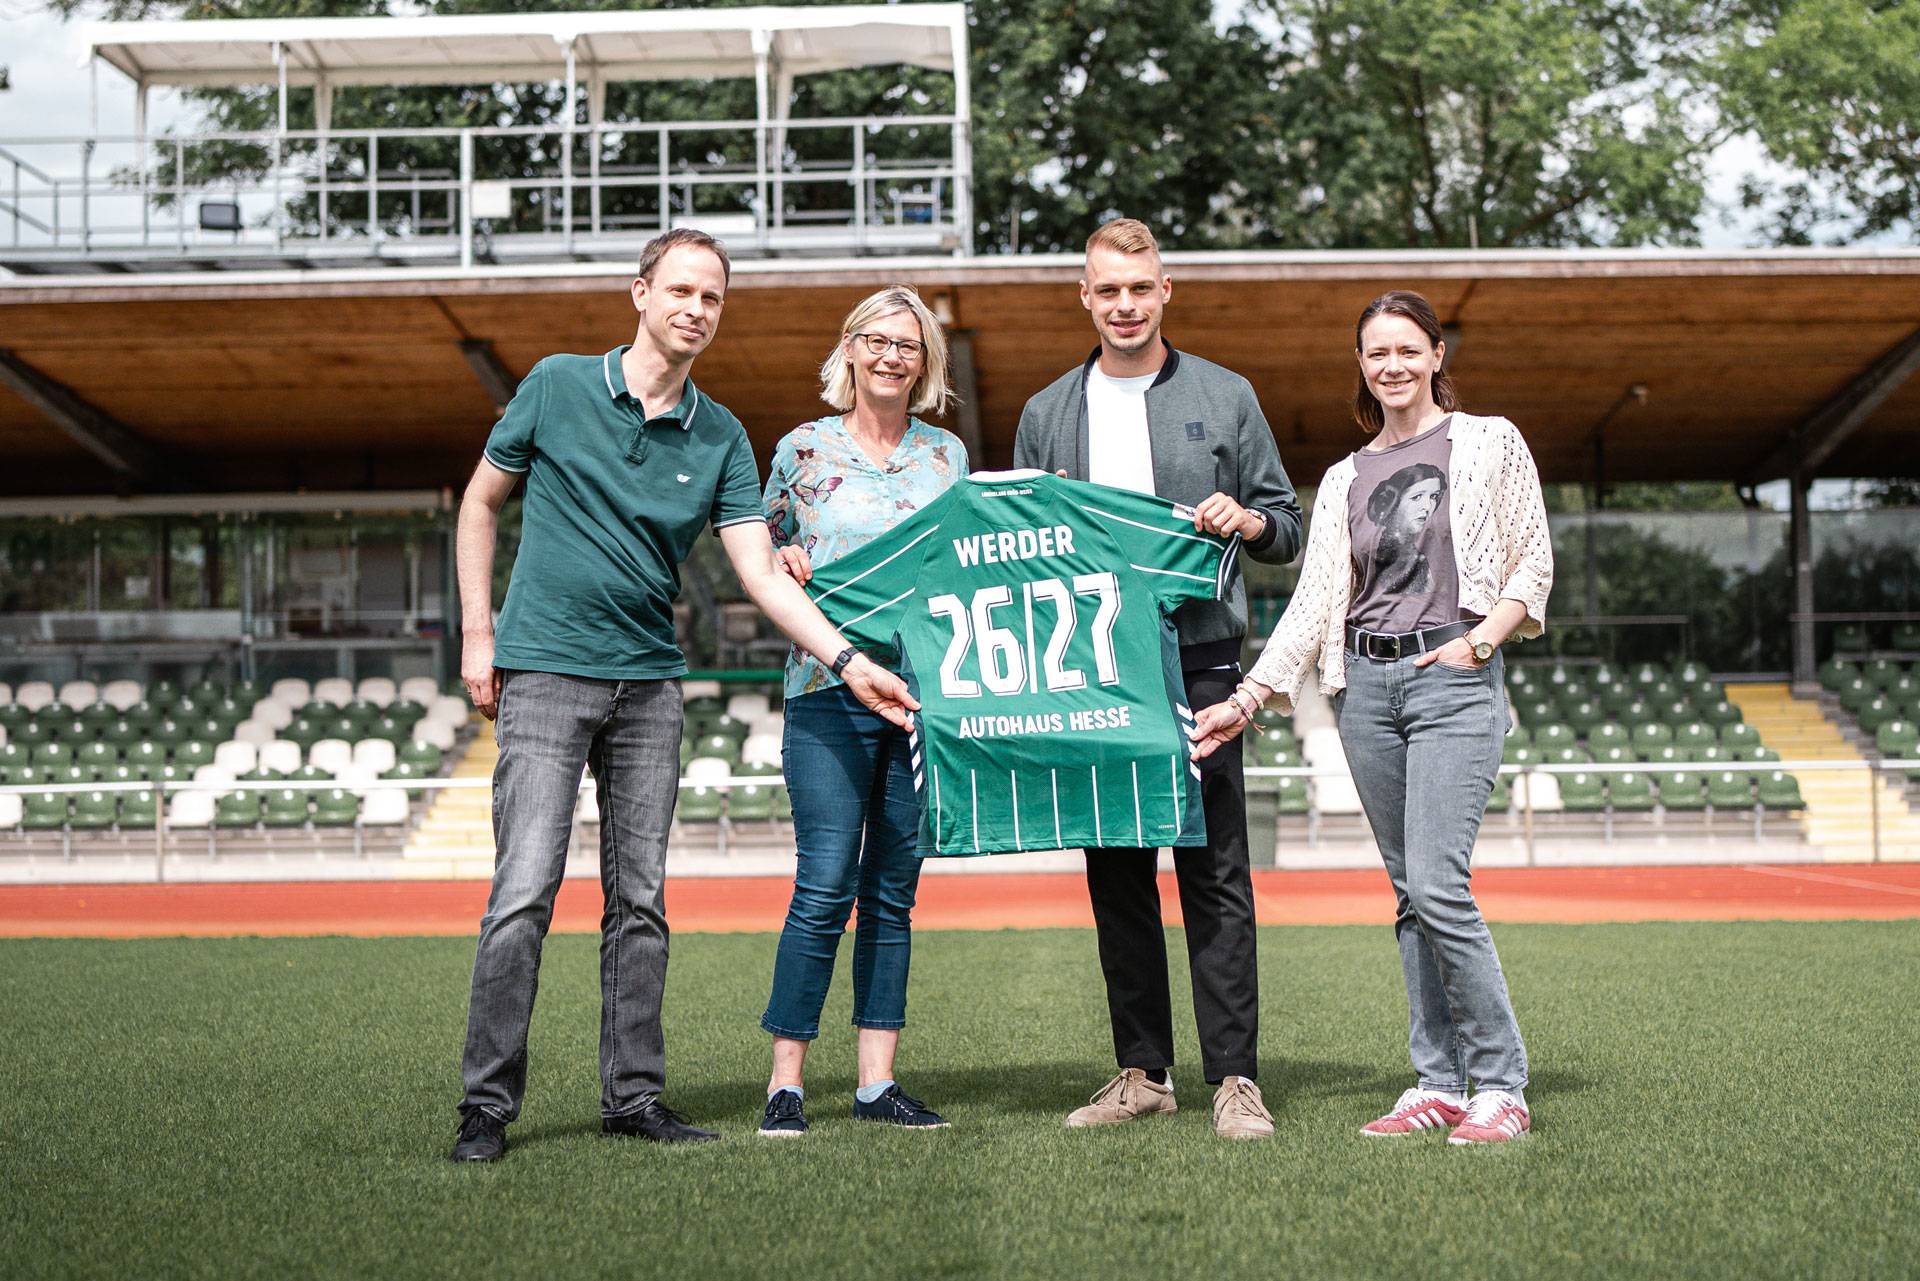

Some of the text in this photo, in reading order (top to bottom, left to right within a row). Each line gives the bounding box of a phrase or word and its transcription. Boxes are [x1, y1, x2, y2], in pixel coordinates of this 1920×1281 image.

[952, 524, 1077, 568] WERDER
[958, 705, 1132, 739] AUTOHAUS HESSE
